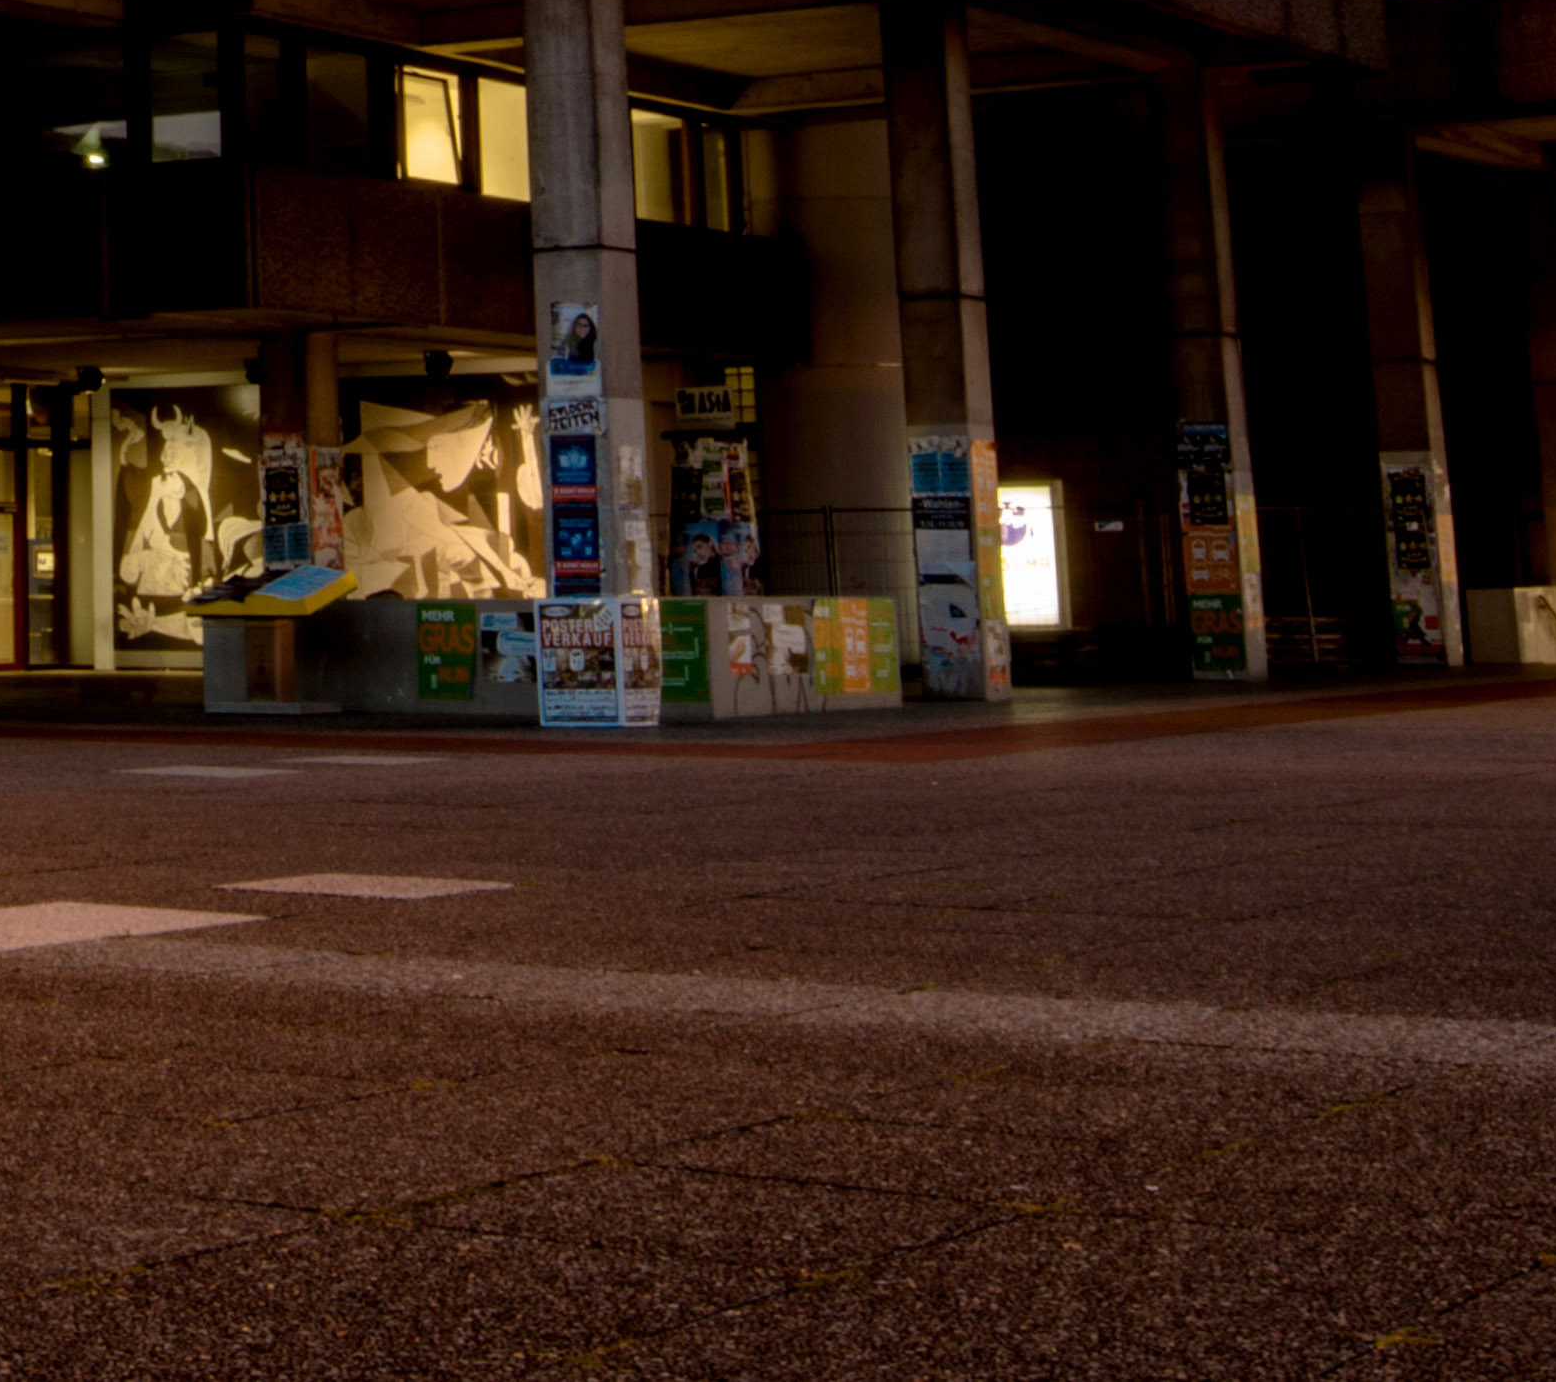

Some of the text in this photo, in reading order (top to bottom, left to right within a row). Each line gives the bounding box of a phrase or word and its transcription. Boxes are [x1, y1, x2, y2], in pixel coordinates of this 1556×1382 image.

[421, 609, 455, 623] MEHR
[542, 618, 593, 633] POSTER
[418, 622, 475, 653] GRAS
